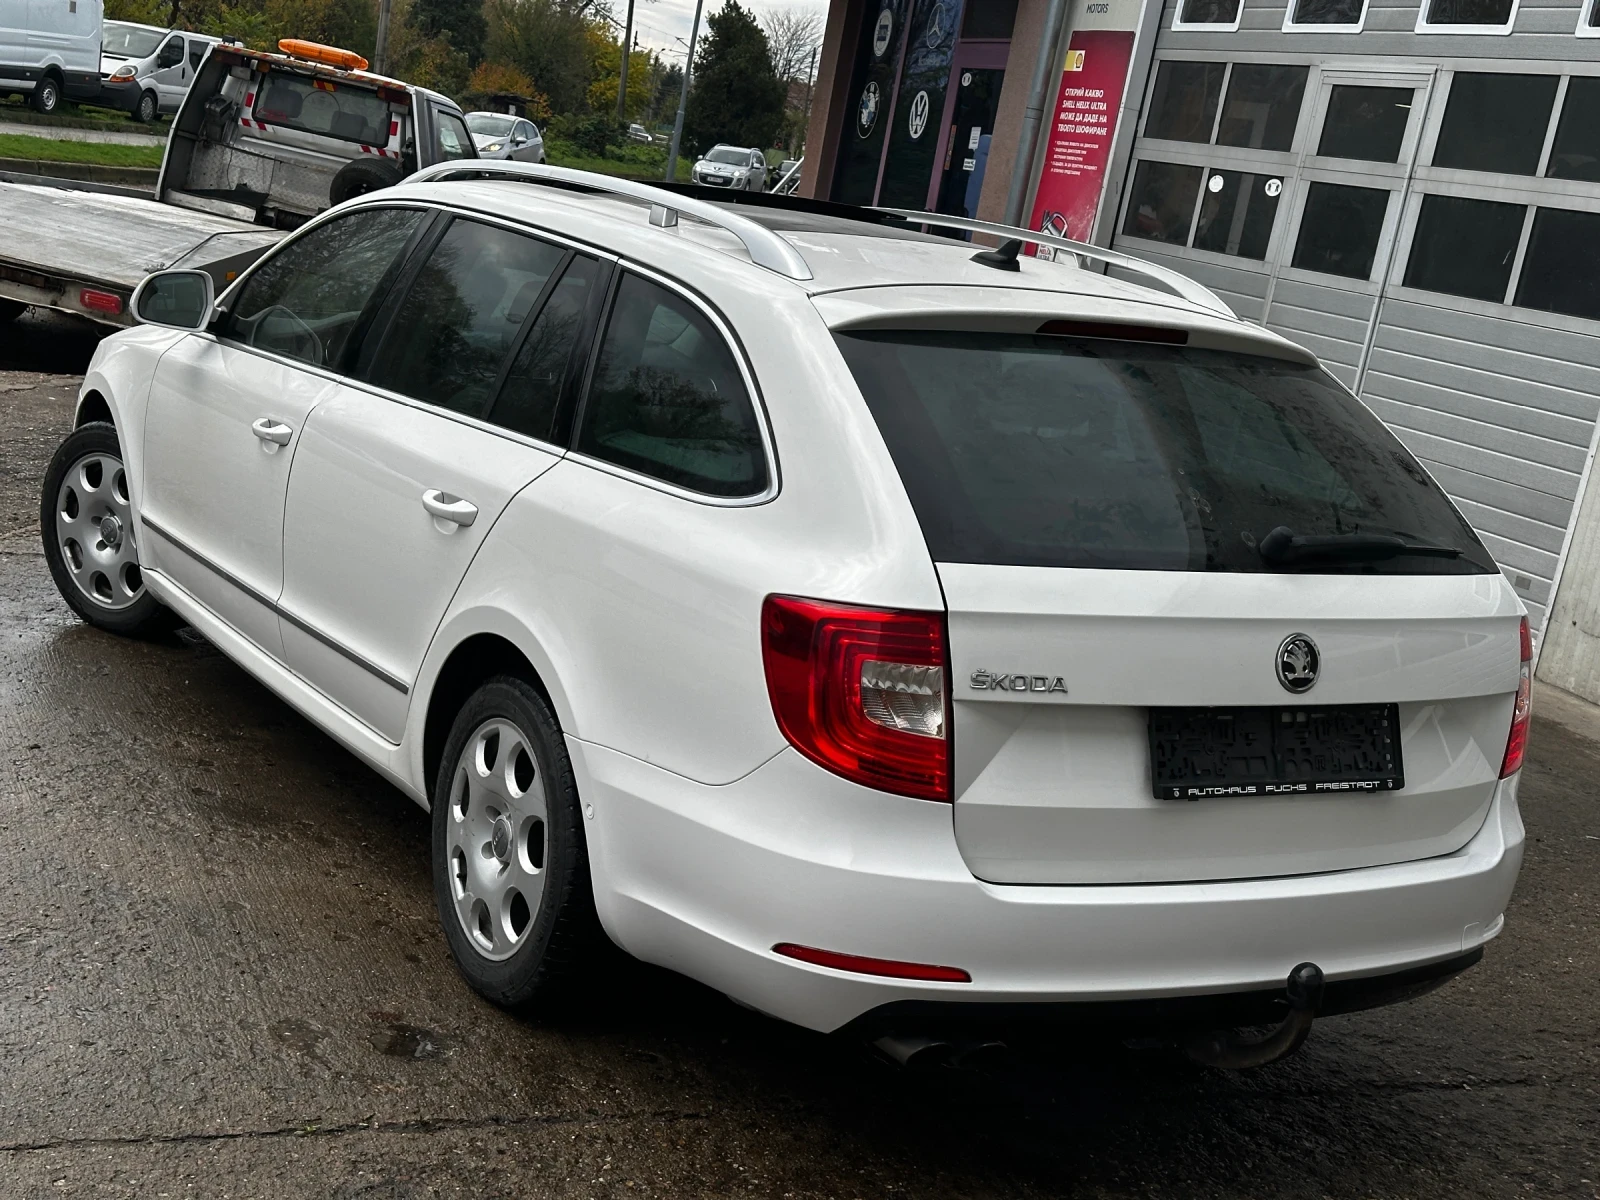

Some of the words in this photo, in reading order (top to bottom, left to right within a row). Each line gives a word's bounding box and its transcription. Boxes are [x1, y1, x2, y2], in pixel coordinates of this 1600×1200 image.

[1086, 3, 1109, 13] MOTORS
[1065, 87, 1085, 96] ОТКРИЙ
[1085, 89, 1104, 98] КАКВО
[1062, 100, 1076, 108] SHELL
[1076, 101, 1090, 109] HELIX
[1090, 102, 1107, 110] ULTRA
[1060, 112, 1075, 120] МОЖЕ
[1075, 113, 1083, 122] ДА
[1083, 114, 1099, 123] ДАДЕ
[1099, 115, 1107, 123] НА
[1075, 125, 1107, 135] ШОФИРАНЕ
[970, 668, 1068, 693] ŠKODA
[1188, 786, 1257, 796] AUTOHAUS
[1265, 783, 1307, 792] FUCHS
[1315, 781, 1380, 790] FREISTADT
